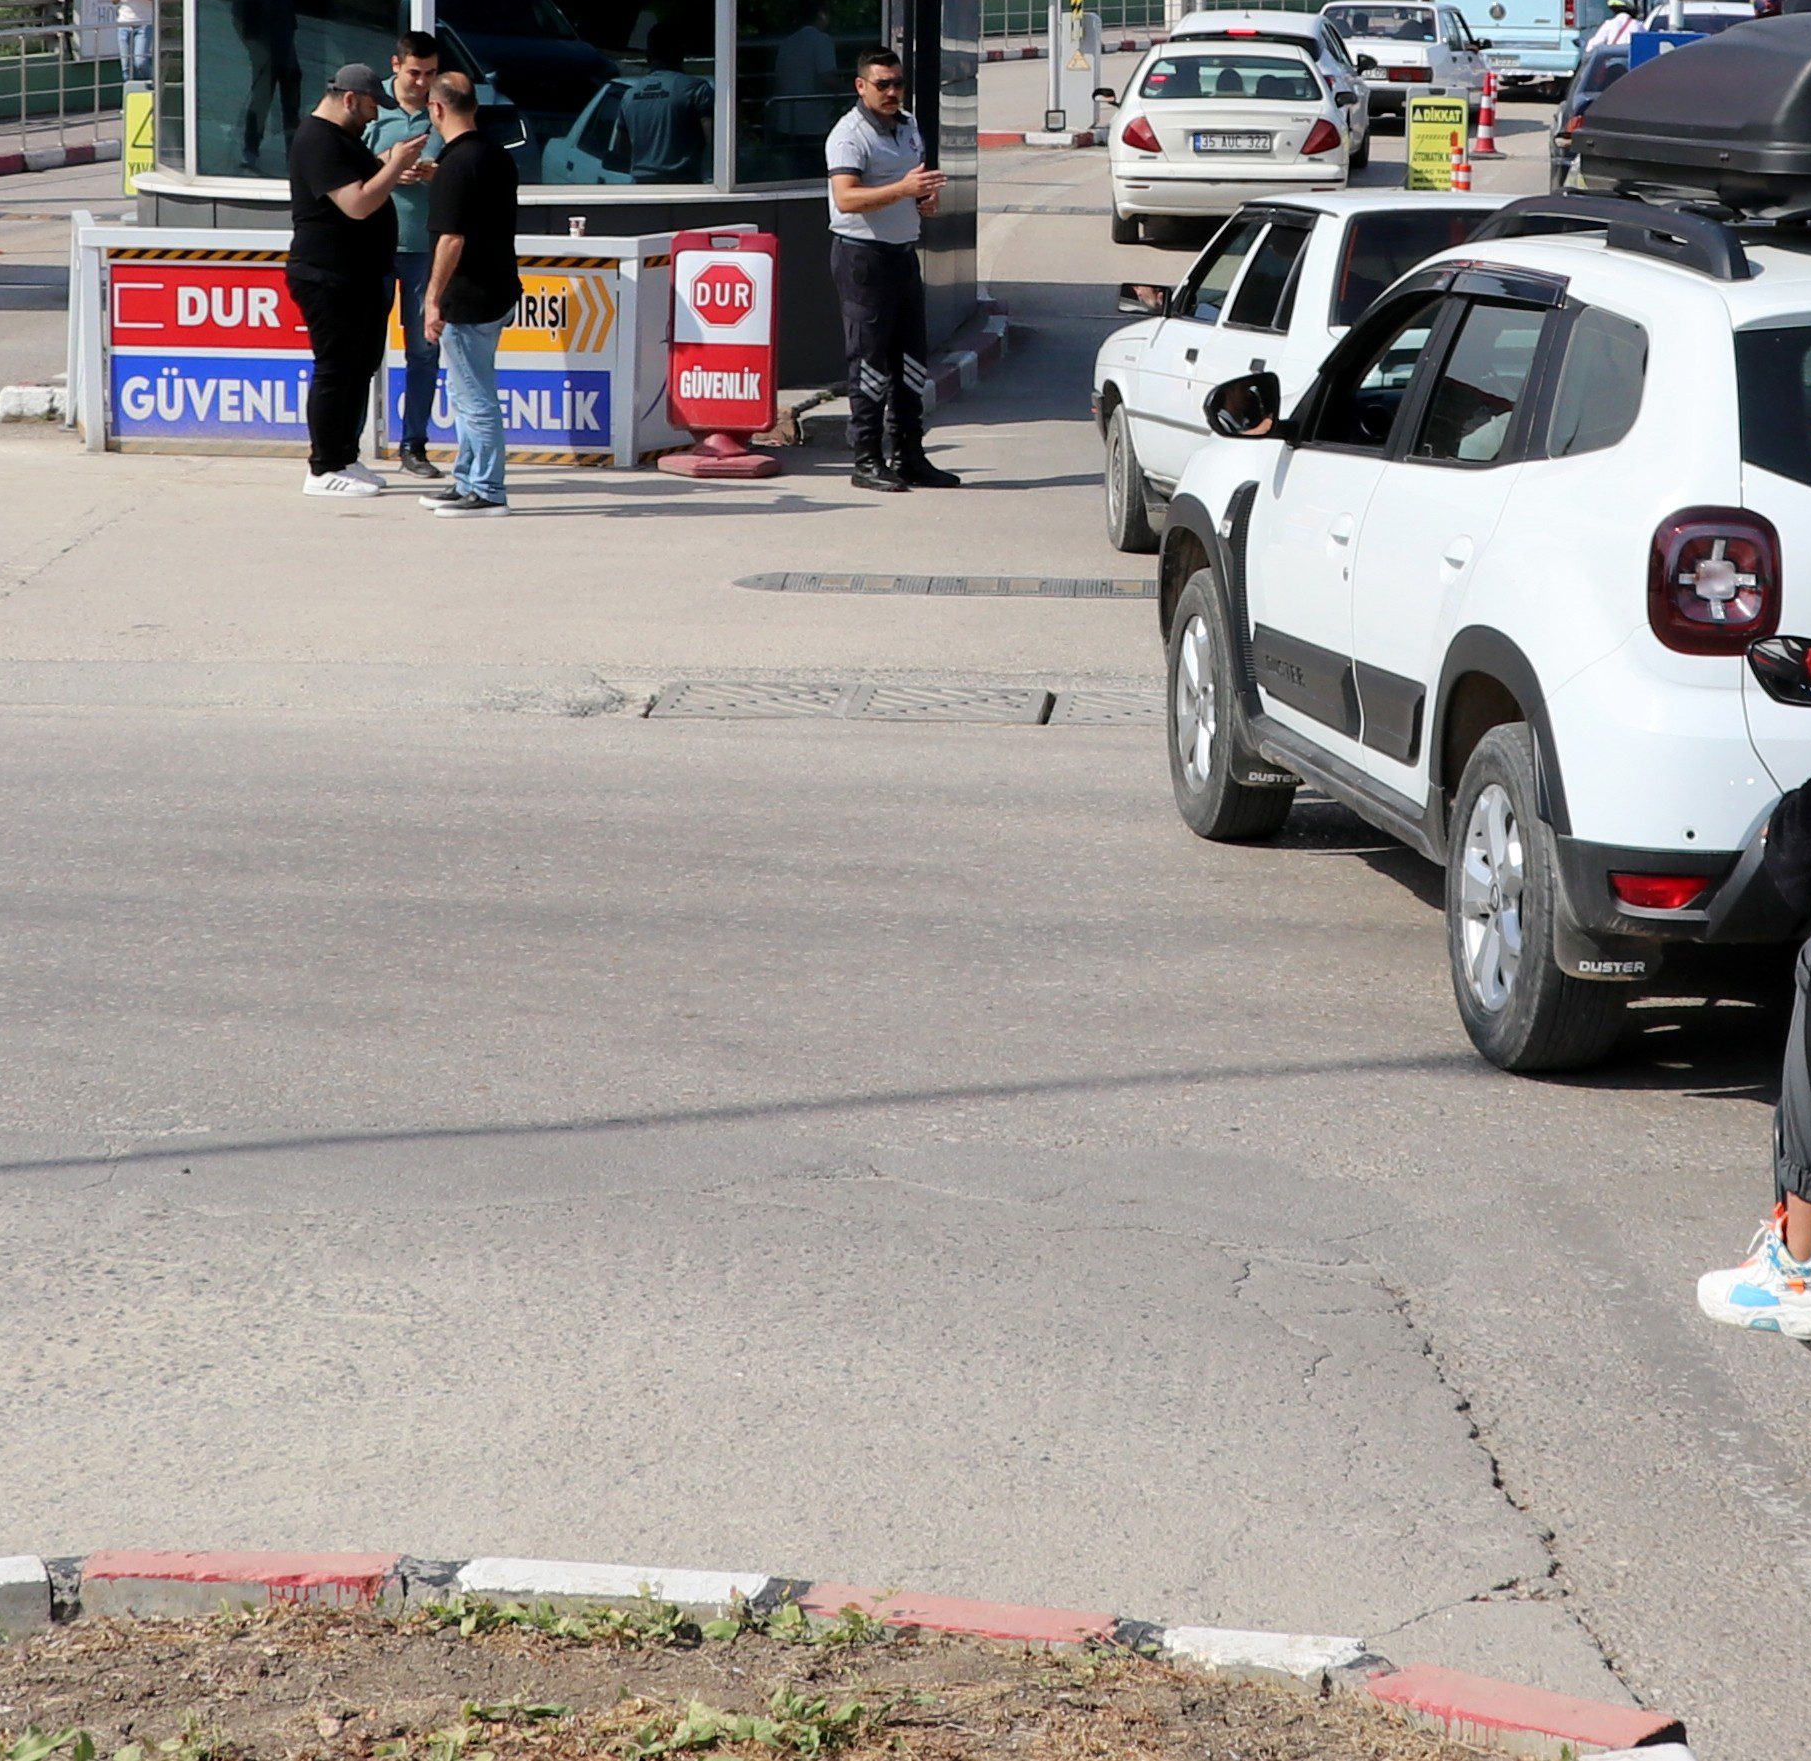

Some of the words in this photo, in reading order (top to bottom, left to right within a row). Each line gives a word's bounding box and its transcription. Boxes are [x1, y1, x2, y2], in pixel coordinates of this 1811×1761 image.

[1423, 107, 1462, 122] DİKKAT
[1202, 133, 1216, 149] 35
[1248, 134, 1269, 150] 322
[177, 285, 281, 328] DUR
[696, 282, 750, 308] DUR
[120, 366, 309, 424] GÜVENLİ
[680, 365, 761, 401] GÜVENLİK
[1578, 960, 1647, 973] DUSTER
